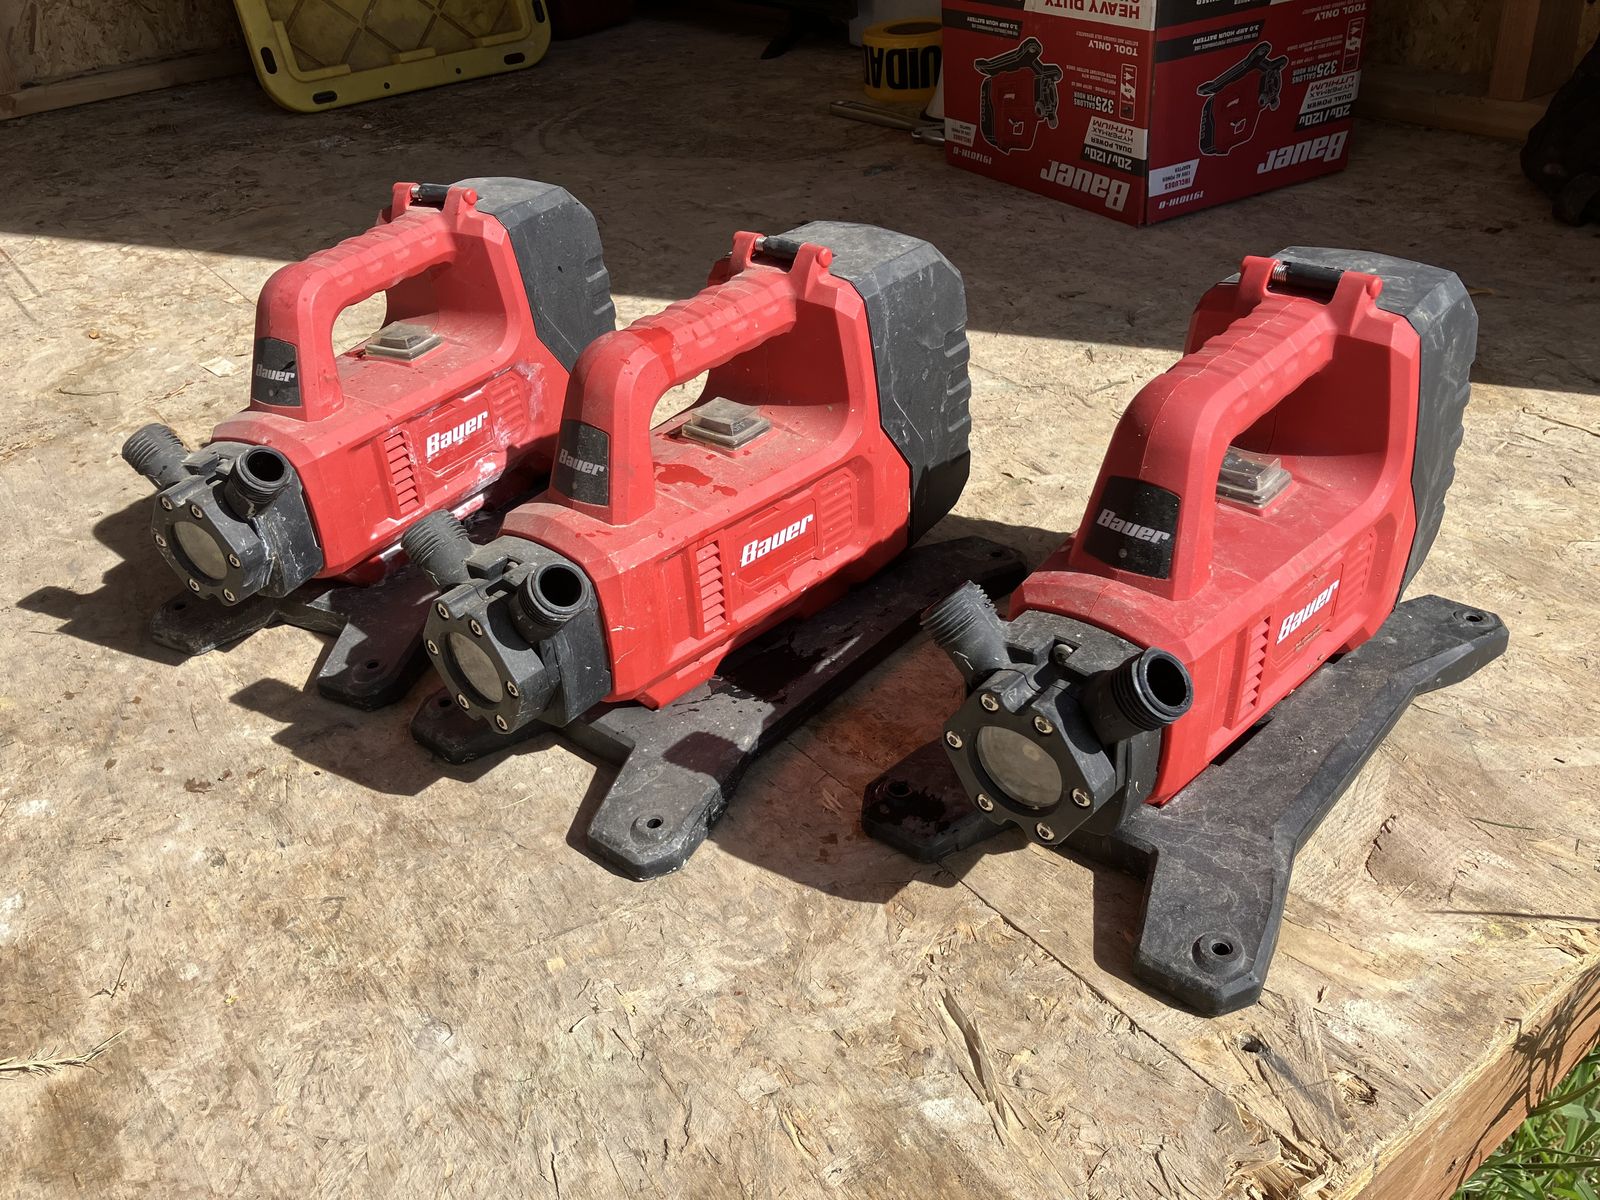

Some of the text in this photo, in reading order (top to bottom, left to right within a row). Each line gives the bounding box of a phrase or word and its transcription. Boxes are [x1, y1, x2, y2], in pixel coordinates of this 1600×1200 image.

[1089, 0, 1140, 20] HEAVY
[1314, 9, 1339, 21] ONLY
[1342, 2, 1367, 15] TOOL
[1192, 34, 1217, 45] BATTERY
[1218, 29, 1235, 39] HOUR
[1236, 27, 1248, 35] AMP
[1088, 40, 1138, 56] TOOL ONLY
[863, 45, 942, 90] UIDA
[1316, 60, 1338, 77] 325
[1309, 82, 1355, 98] HYPERMAX
[1310, 75, 1355, 92] LITHIUM
[1094, 95, 1114, 114] 325
[1307, 92, 1352, 109] DUAL POWER
[1092, 127, 1134, 143] HYPERMAX
[1093, 119, 1134, 136] LITHIUM
[1090, 136, 1133, 153] DUAL POWER
[1256, 129, 1349, 175] Bauer
[1039, 161, 1131, 212] Bauer
[1164, 177, 1191, 190] INCLUDES
[255, 363, 295, 383] Bauer
[426, 411, 488, 458] Bauer
[558, 448, 605, 476] Bauer
[1096, 508, 1170, 544] Bauer
[740, 513, 814, 567] Bauer
[1276, 579, 1340, 645] Bauer
